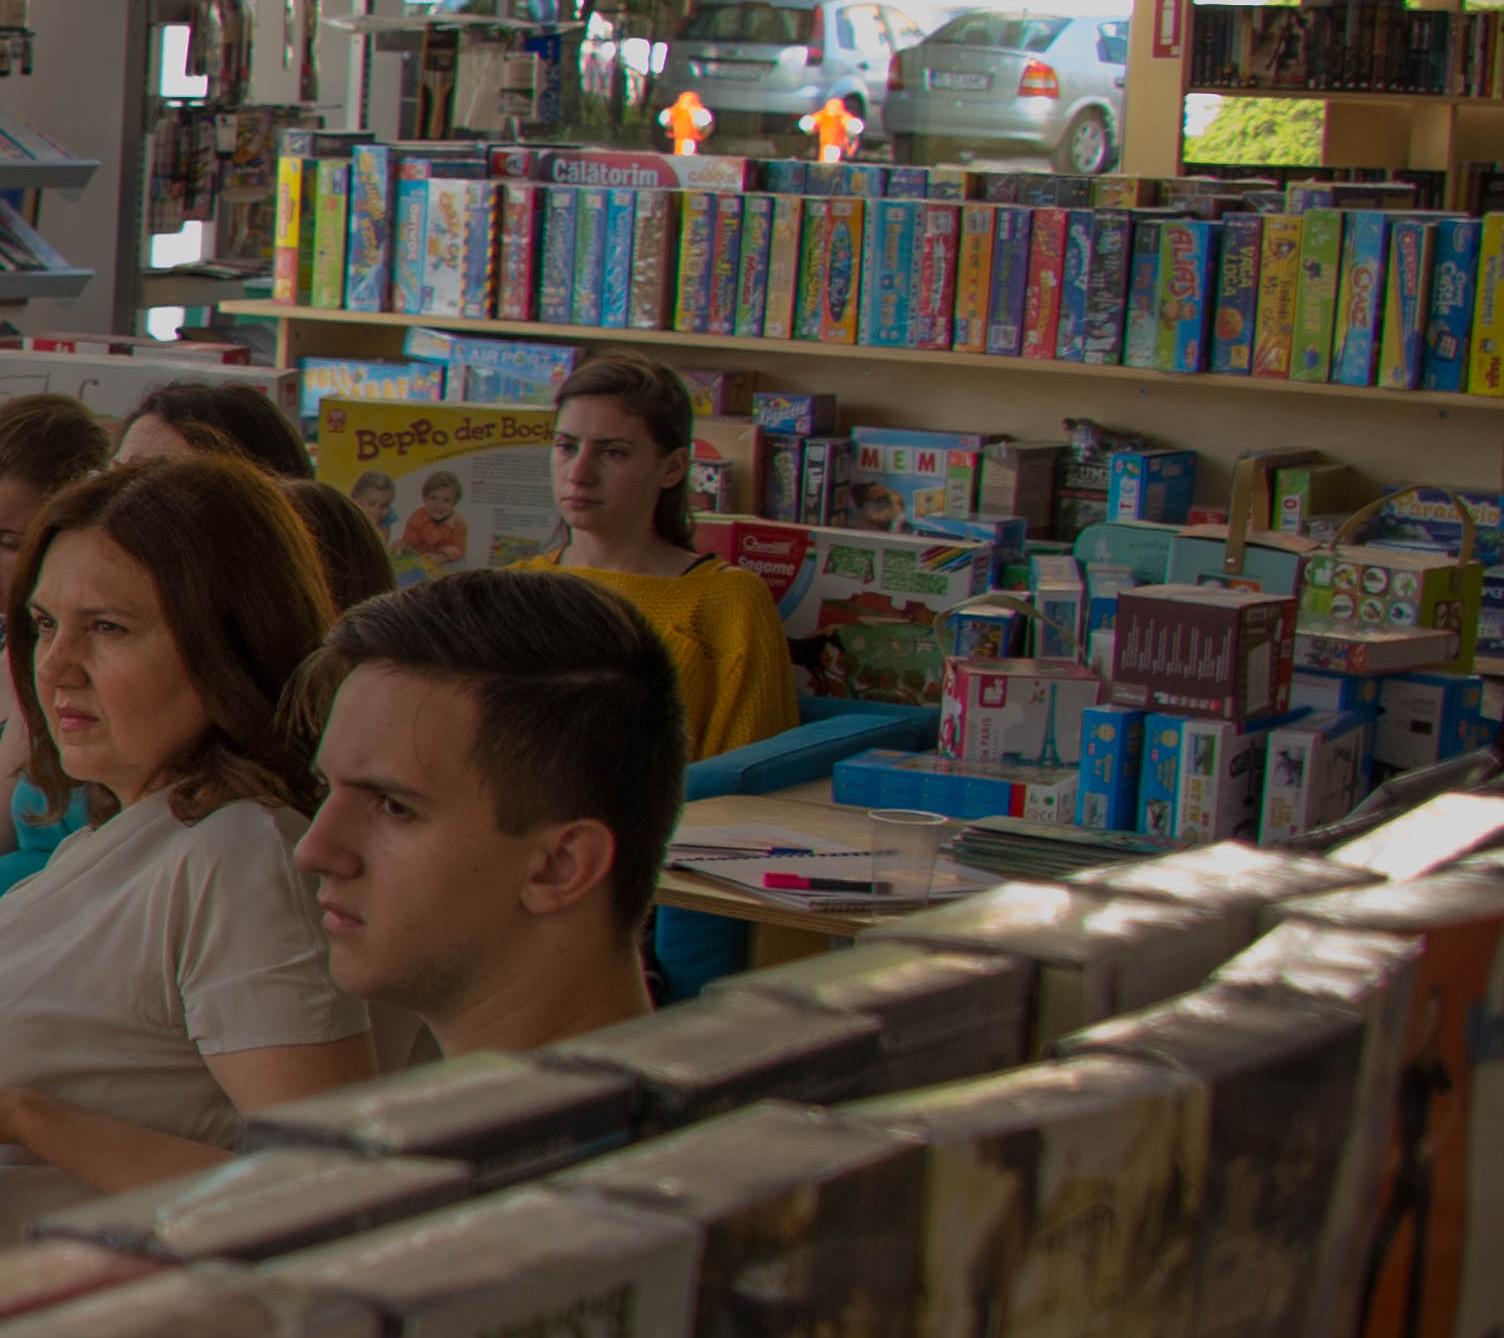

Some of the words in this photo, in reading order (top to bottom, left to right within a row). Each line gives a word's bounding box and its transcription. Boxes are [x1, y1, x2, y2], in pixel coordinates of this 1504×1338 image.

[552, 158, 658, 186] Călătorim
[1166, 227, 1199, 300] ALIAS
[354, 418, 449, 461] Beppo
[454, 416, 497, 442] der
[737, 555, 796, 576] Sagome
